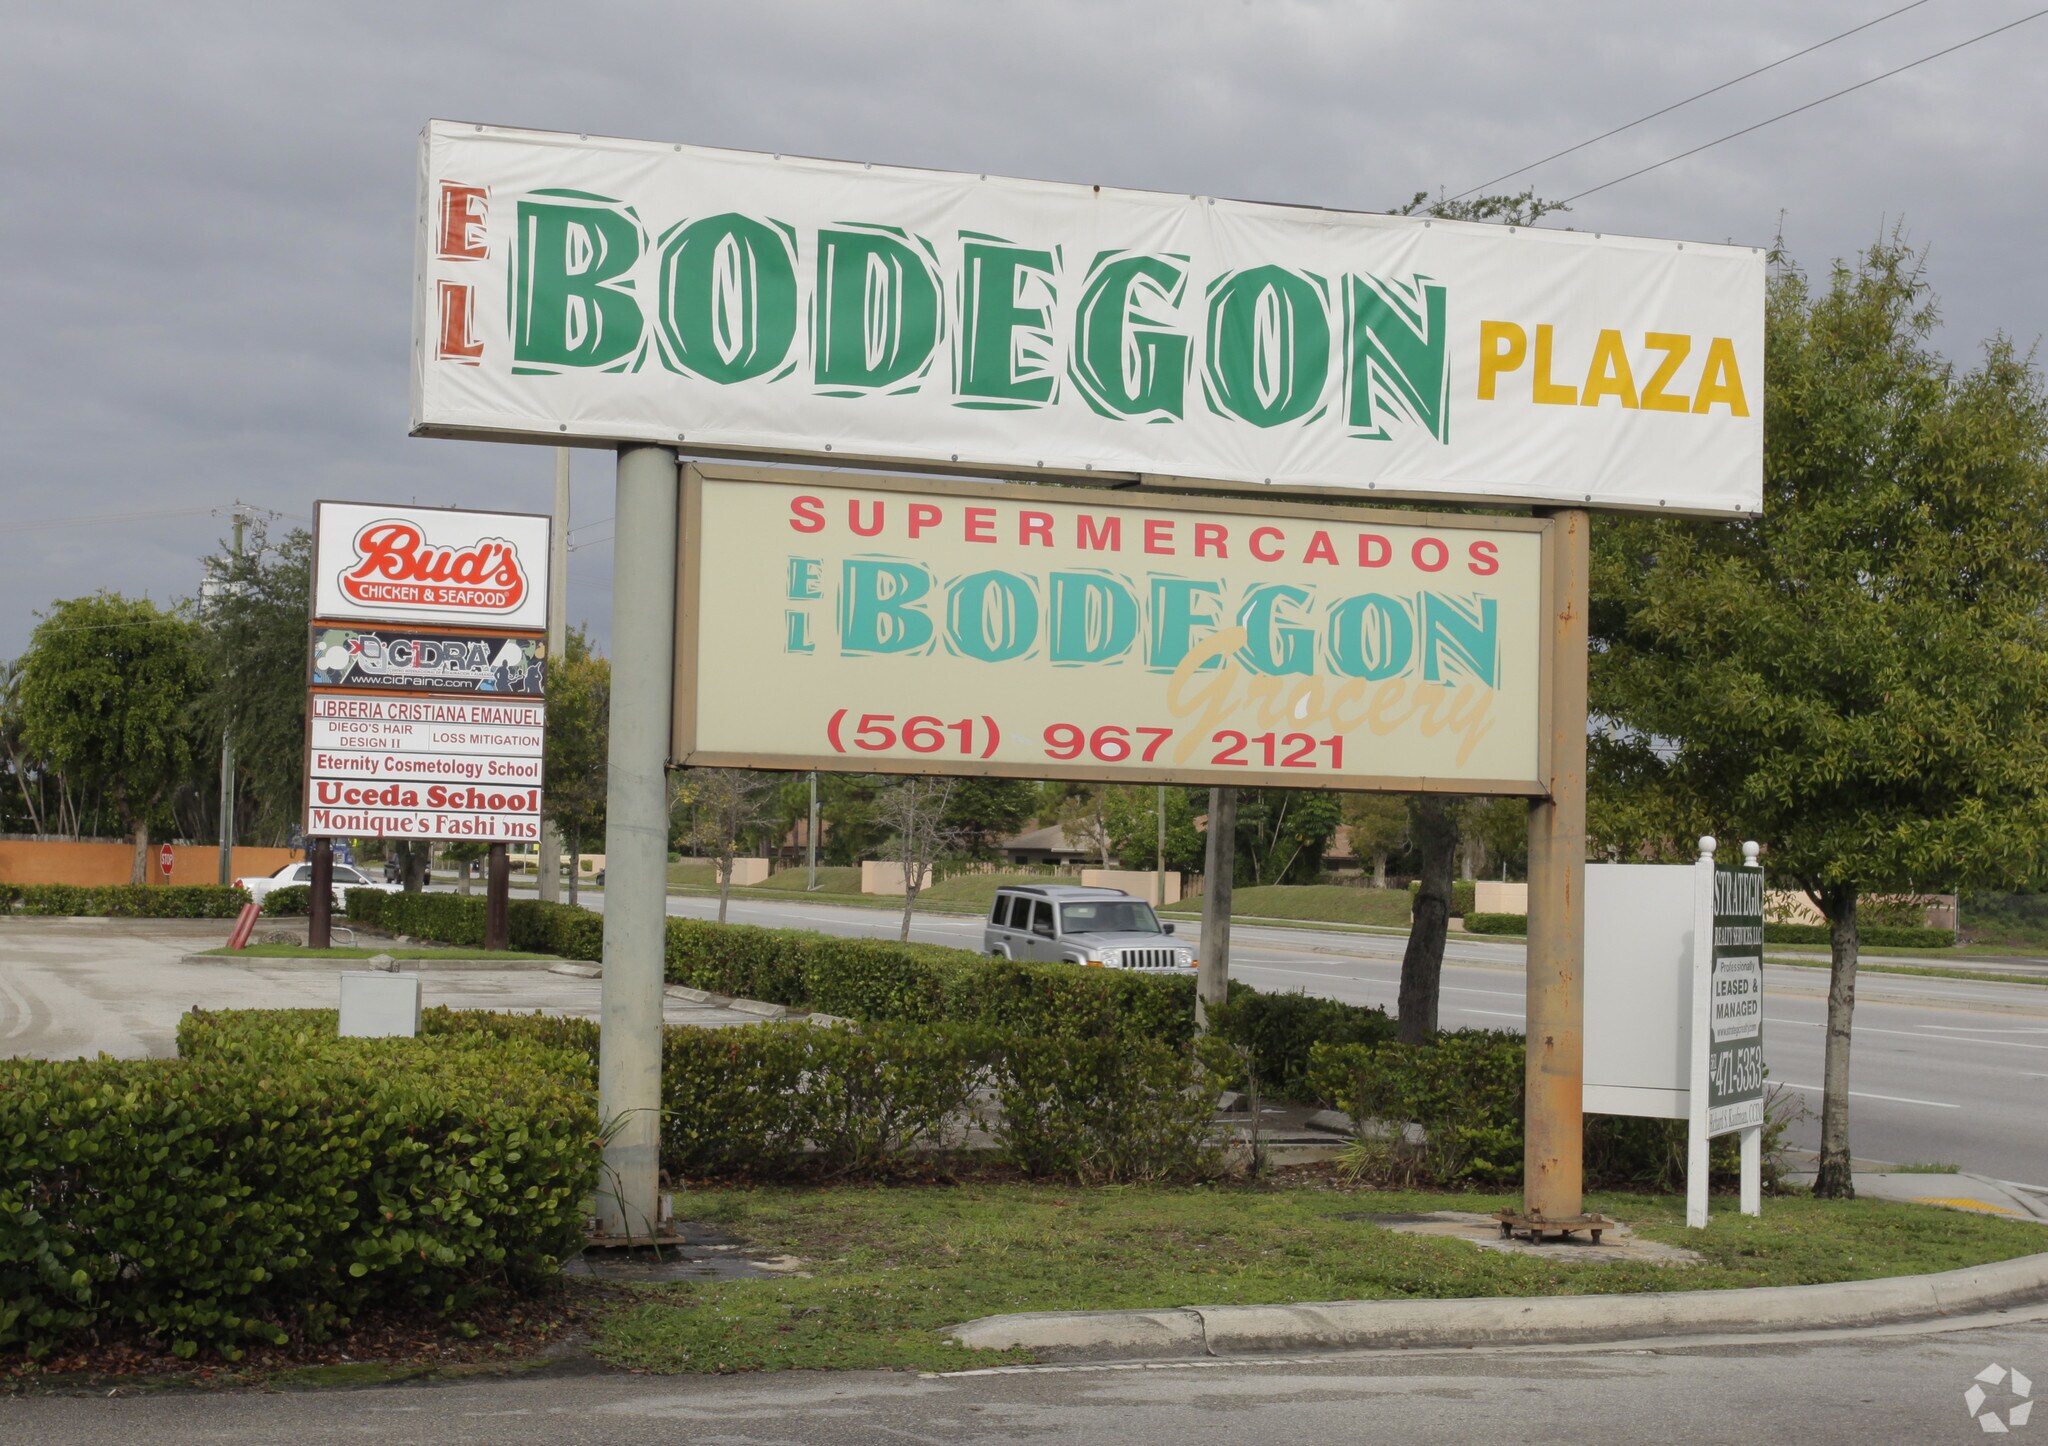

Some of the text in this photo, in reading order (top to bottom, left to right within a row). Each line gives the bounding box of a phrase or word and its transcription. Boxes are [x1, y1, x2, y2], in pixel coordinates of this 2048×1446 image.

[506, 188, 1450, 446] BODEGON
[1477, 319, 1750, 418] PLAZA
[788, 495, 1500, 576] SUPERMERCADOS
[350, 524, 519, 587] Bud's
[359, 584, 506, 606] CHICKEN & SEAFOOD
[837, 552, 1501, 691] BODEGON
[351, 675, 473, 688] www.cidrainc.com
[1166, 626, 1498, 769] Grocery
[313, 700, 542, 726] LIBRERIA CRISTIANA EMANUEL
[328, 721, 413, 735] DIEGO'S HAIR
[433, 732, 540, 747] LOSS MITIGATION
[826, 708, 1344, 770] (561) 967 2121
[340, 737, 401, 749] DESIGN II
[317, 754, 538, 779] Eternity Cosmetology School
[316, 781, 538, 812] Uceda School
[313, 809, 430, 839] Monique's
[161, 853, 174, 866] STOP
[1714, 870, 1763, 917] STRATEGIC
[1714, 926, 1732, 946] REALTY
[1720, 961, 1755, 973] Professionally
[1716, 978, 1758, 997] LEASED &
[1716, 1000, 1758, 1020] MANAGED
[1716, 1045, 1762, 1096] 471-5353
